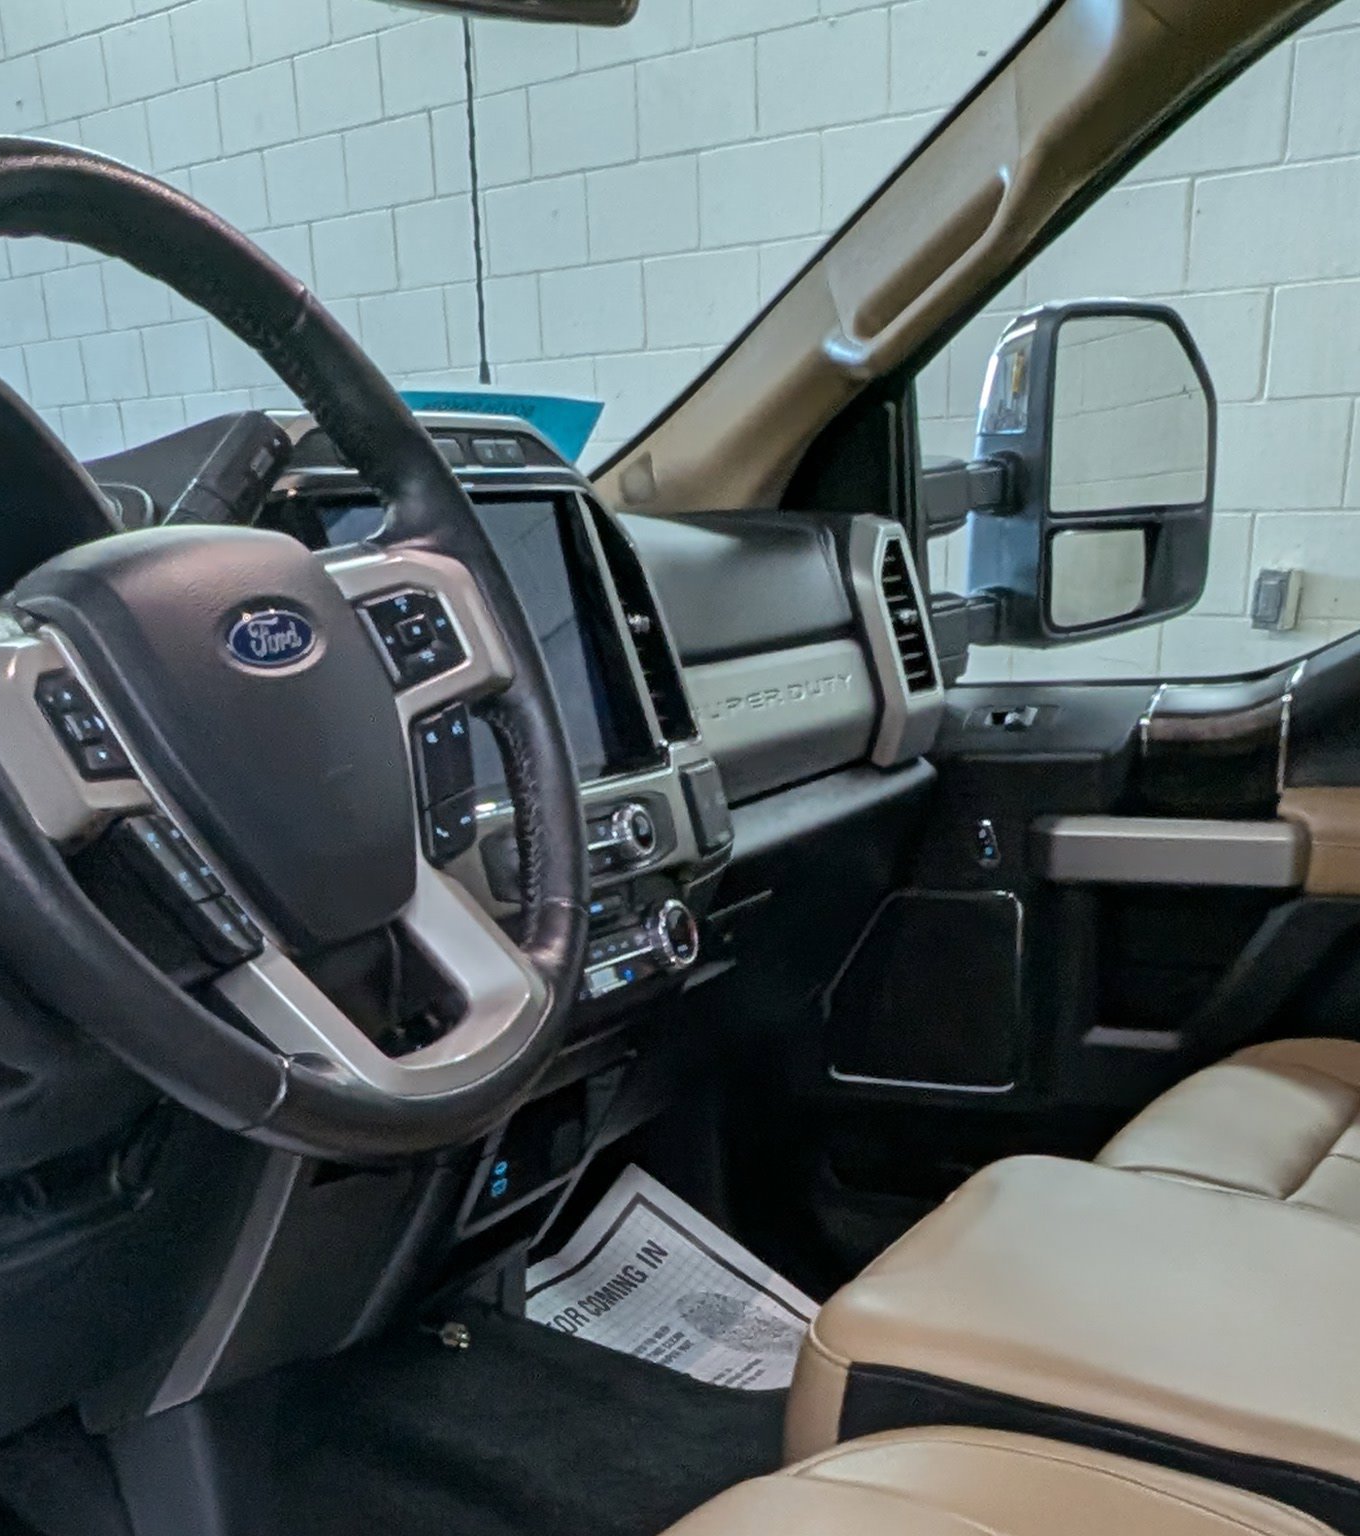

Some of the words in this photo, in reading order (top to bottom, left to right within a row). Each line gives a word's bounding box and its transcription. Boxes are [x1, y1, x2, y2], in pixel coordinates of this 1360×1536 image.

[247, 616, 302, 657] Ford
[702, 688, 784, 720] UPER
[787, 674, 852, 701] DUTY
[546, 1307, 590, 1335] OR
[578, 1265, 648, 1317] COMING
[636, 1239, 668, 1269] IN
